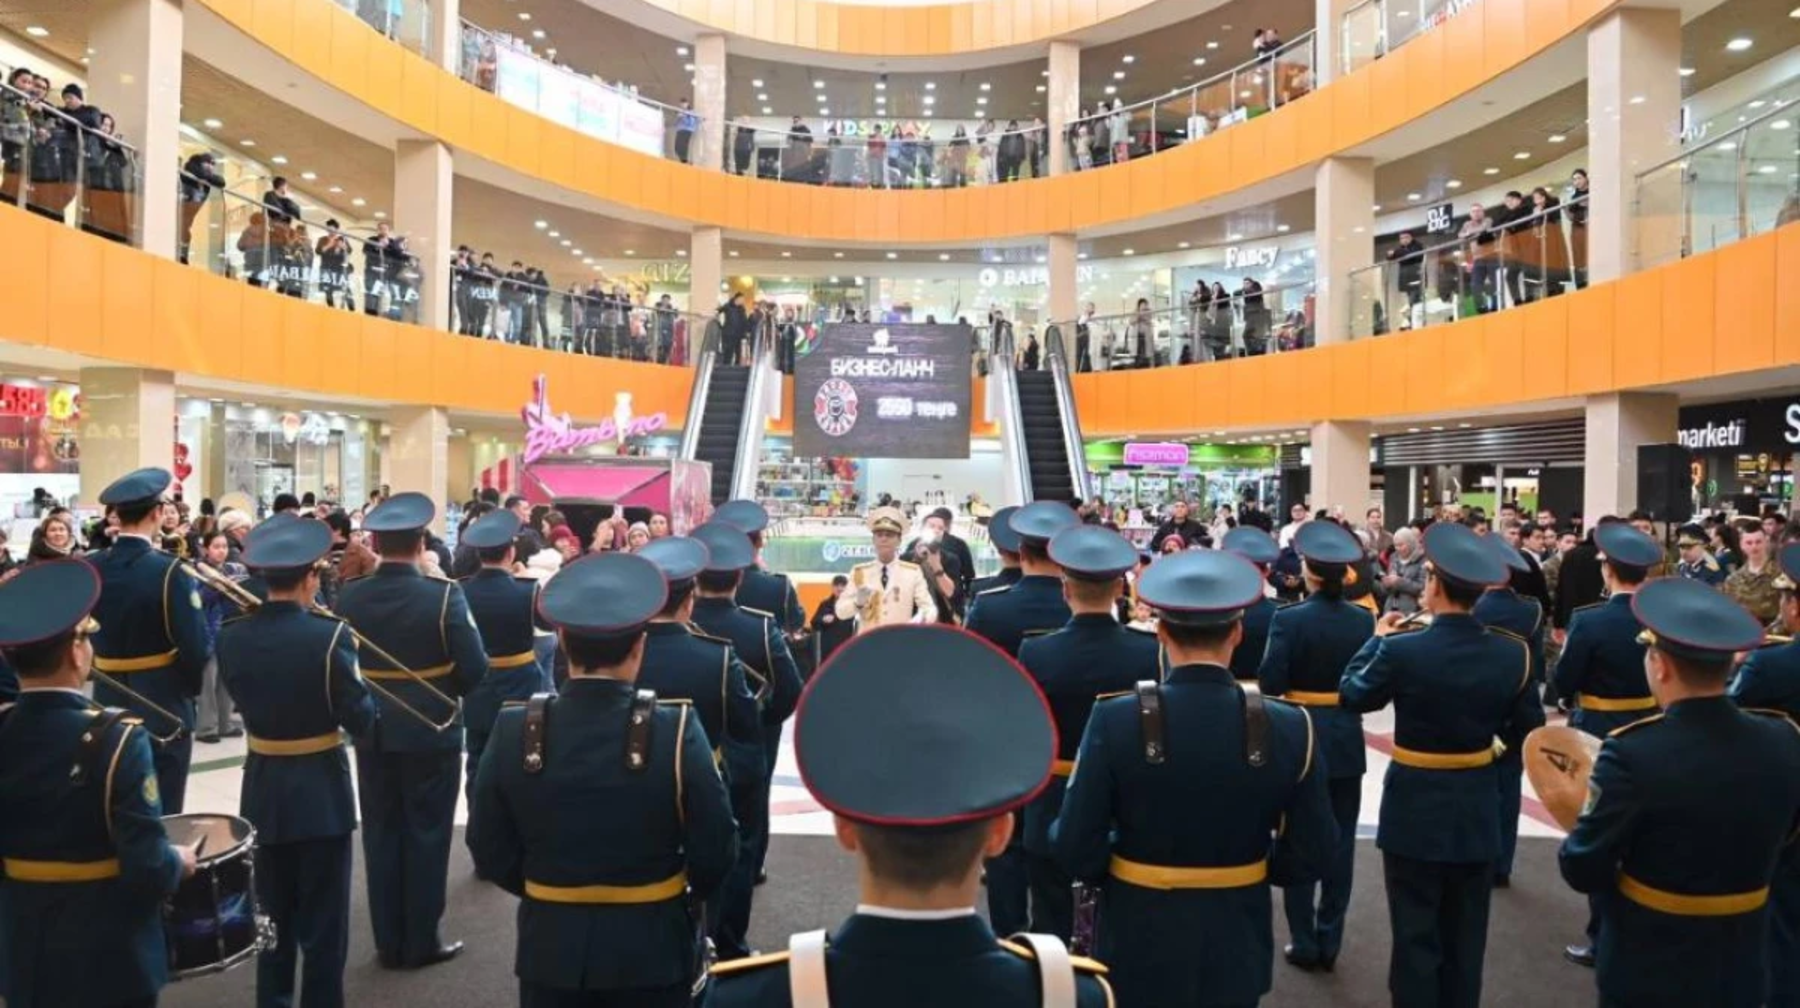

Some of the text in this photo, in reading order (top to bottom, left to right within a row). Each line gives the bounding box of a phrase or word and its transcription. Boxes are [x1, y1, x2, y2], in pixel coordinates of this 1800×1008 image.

[823, 120, 869, 136] KIDS
[1224, 246, 1279, 271] Fancy
[830, 358, 935, 377] БИЗНЕС-ЛАНЧ
